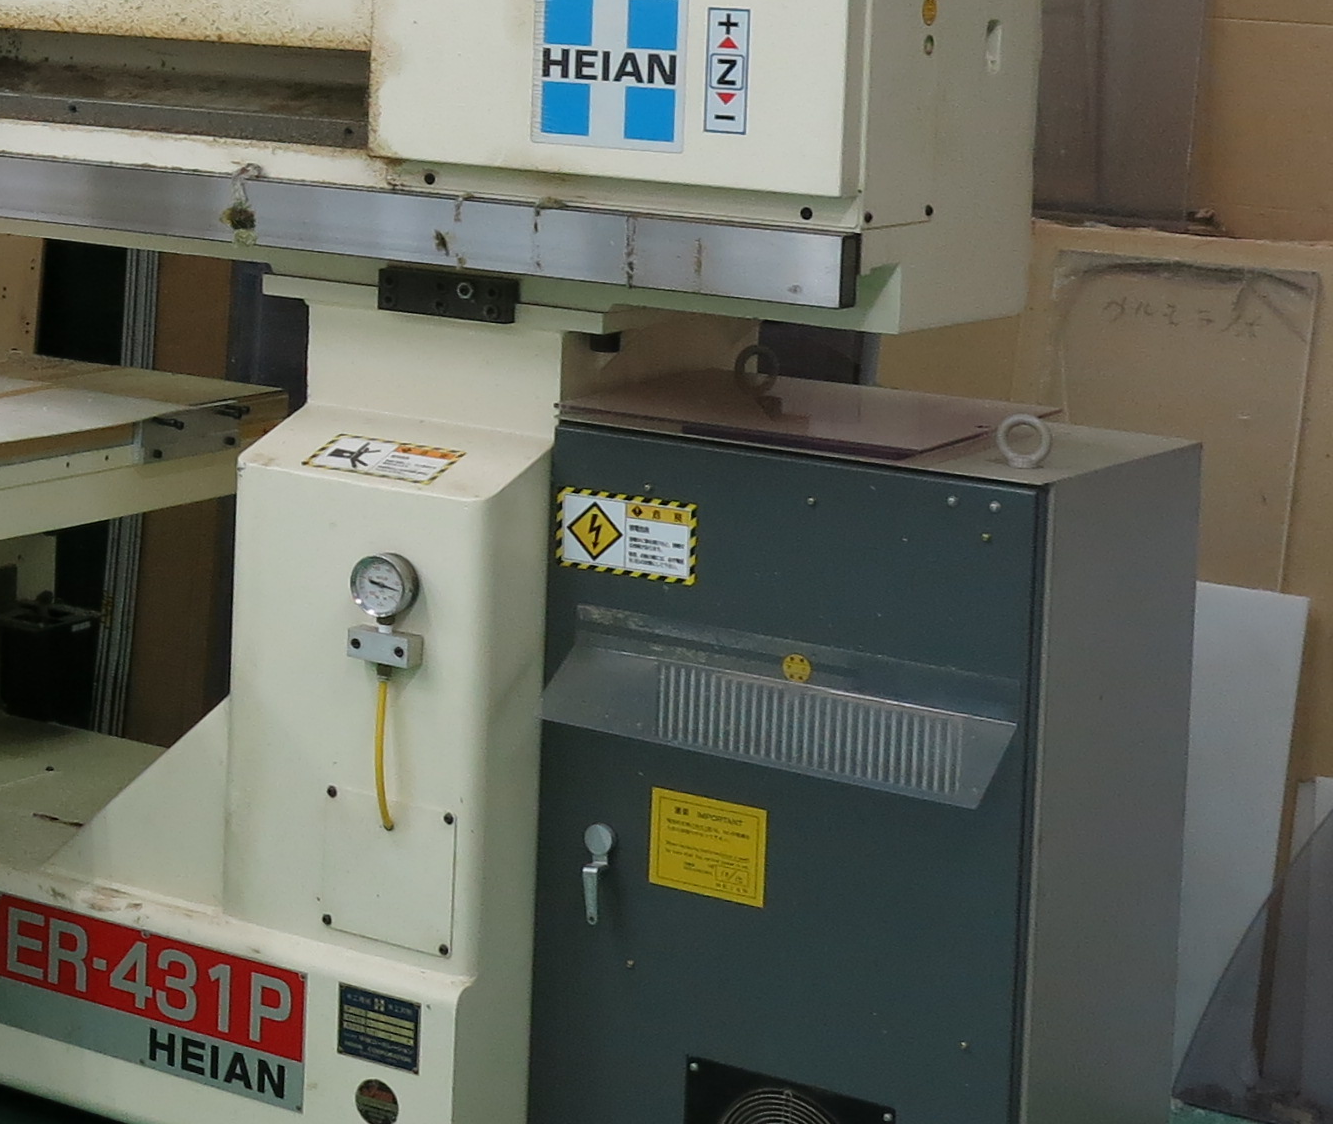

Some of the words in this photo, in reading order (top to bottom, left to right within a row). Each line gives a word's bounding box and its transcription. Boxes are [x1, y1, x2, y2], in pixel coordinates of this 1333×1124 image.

[541, 46, 678, 86] HEIAN
[716, 58, 737, 86] Z
[6, 906, 292, 1043] ER-431P
[148, 1026, 286, 1100] HEIAN
